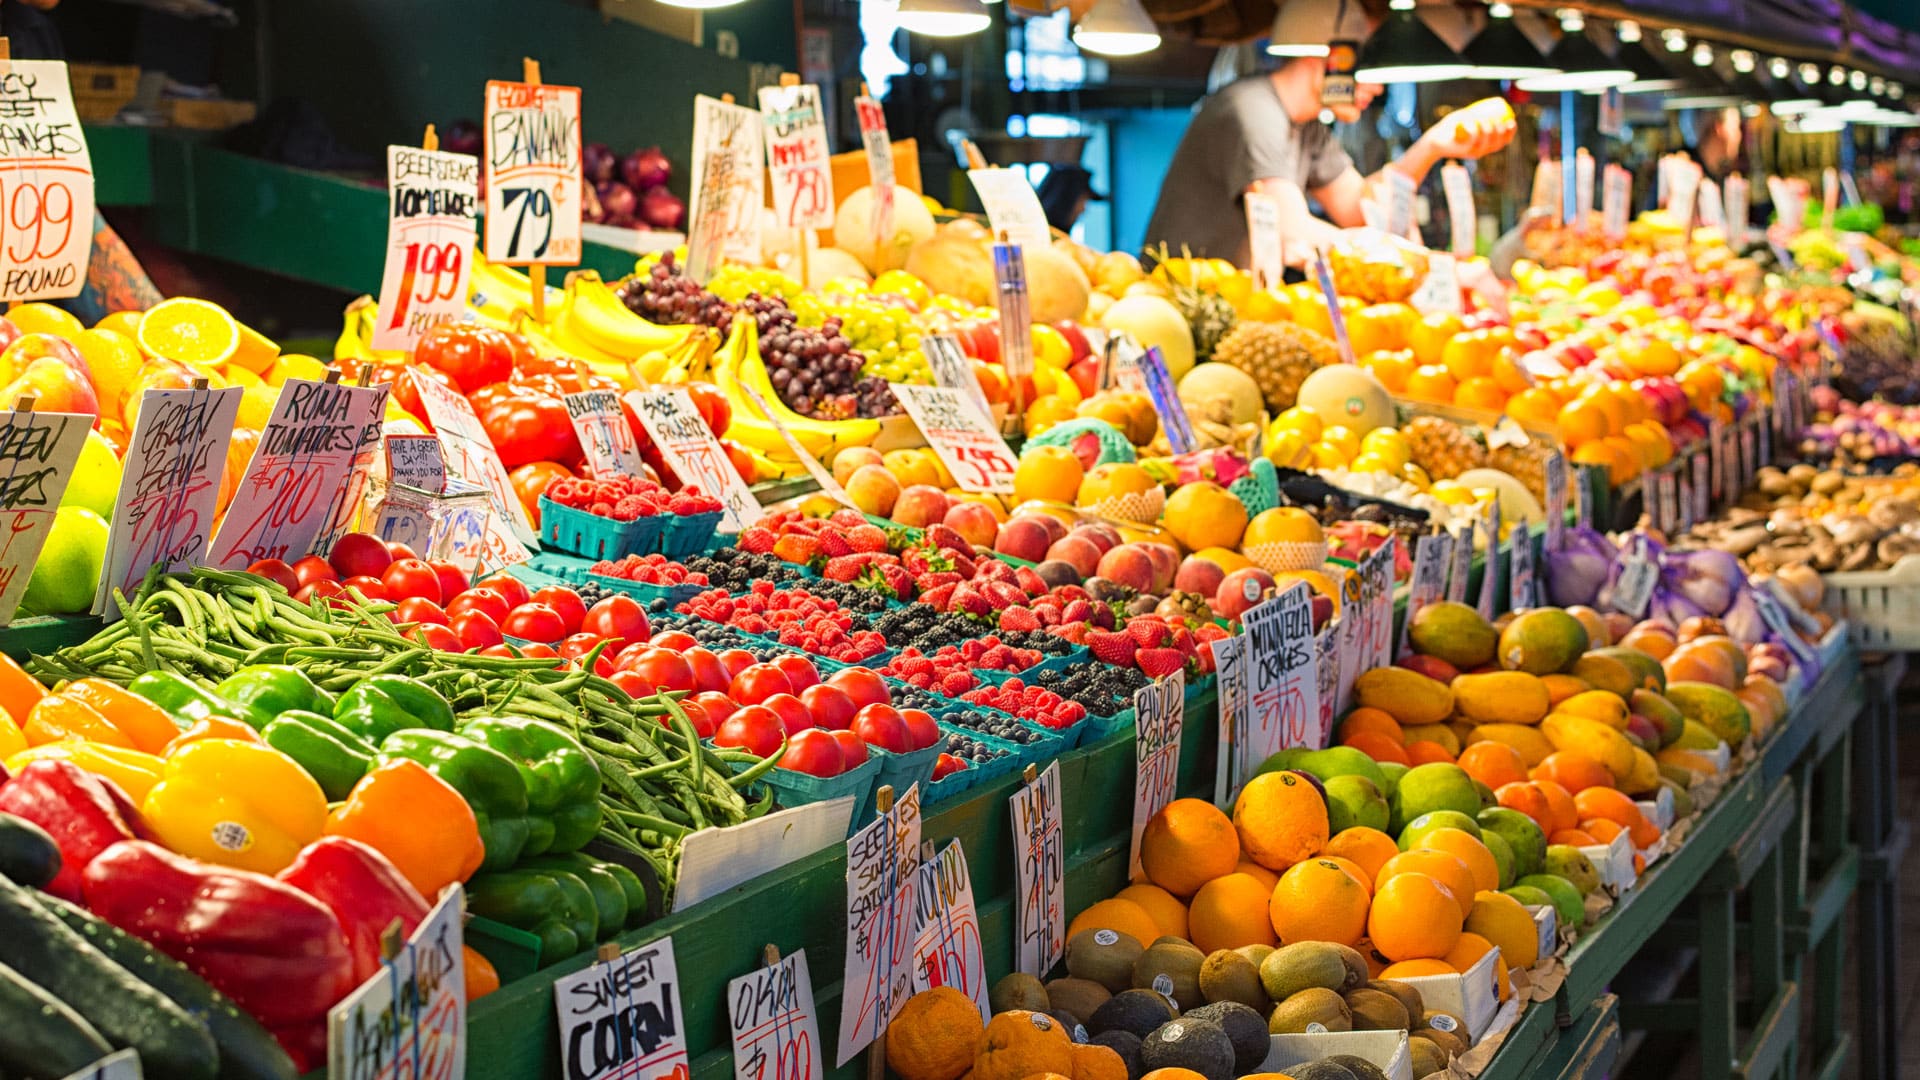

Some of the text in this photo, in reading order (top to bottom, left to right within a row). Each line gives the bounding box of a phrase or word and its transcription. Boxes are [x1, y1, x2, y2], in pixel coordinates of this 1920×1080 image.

[0, 73, 37, 101] CY
[3, 263, 76, 297] POUND
[142, 391, 225, 452] GREEN
[284, 383, 353, 423] ROMA
[390, 439, 408, 454] HAVE
[393, 466, 443, 478] THANK YOU FOR
[570, 948, 660, 1015] SWEET
[735, 956, 799, 1030] OKRA
[567, 982, 676, 1080] CORN
